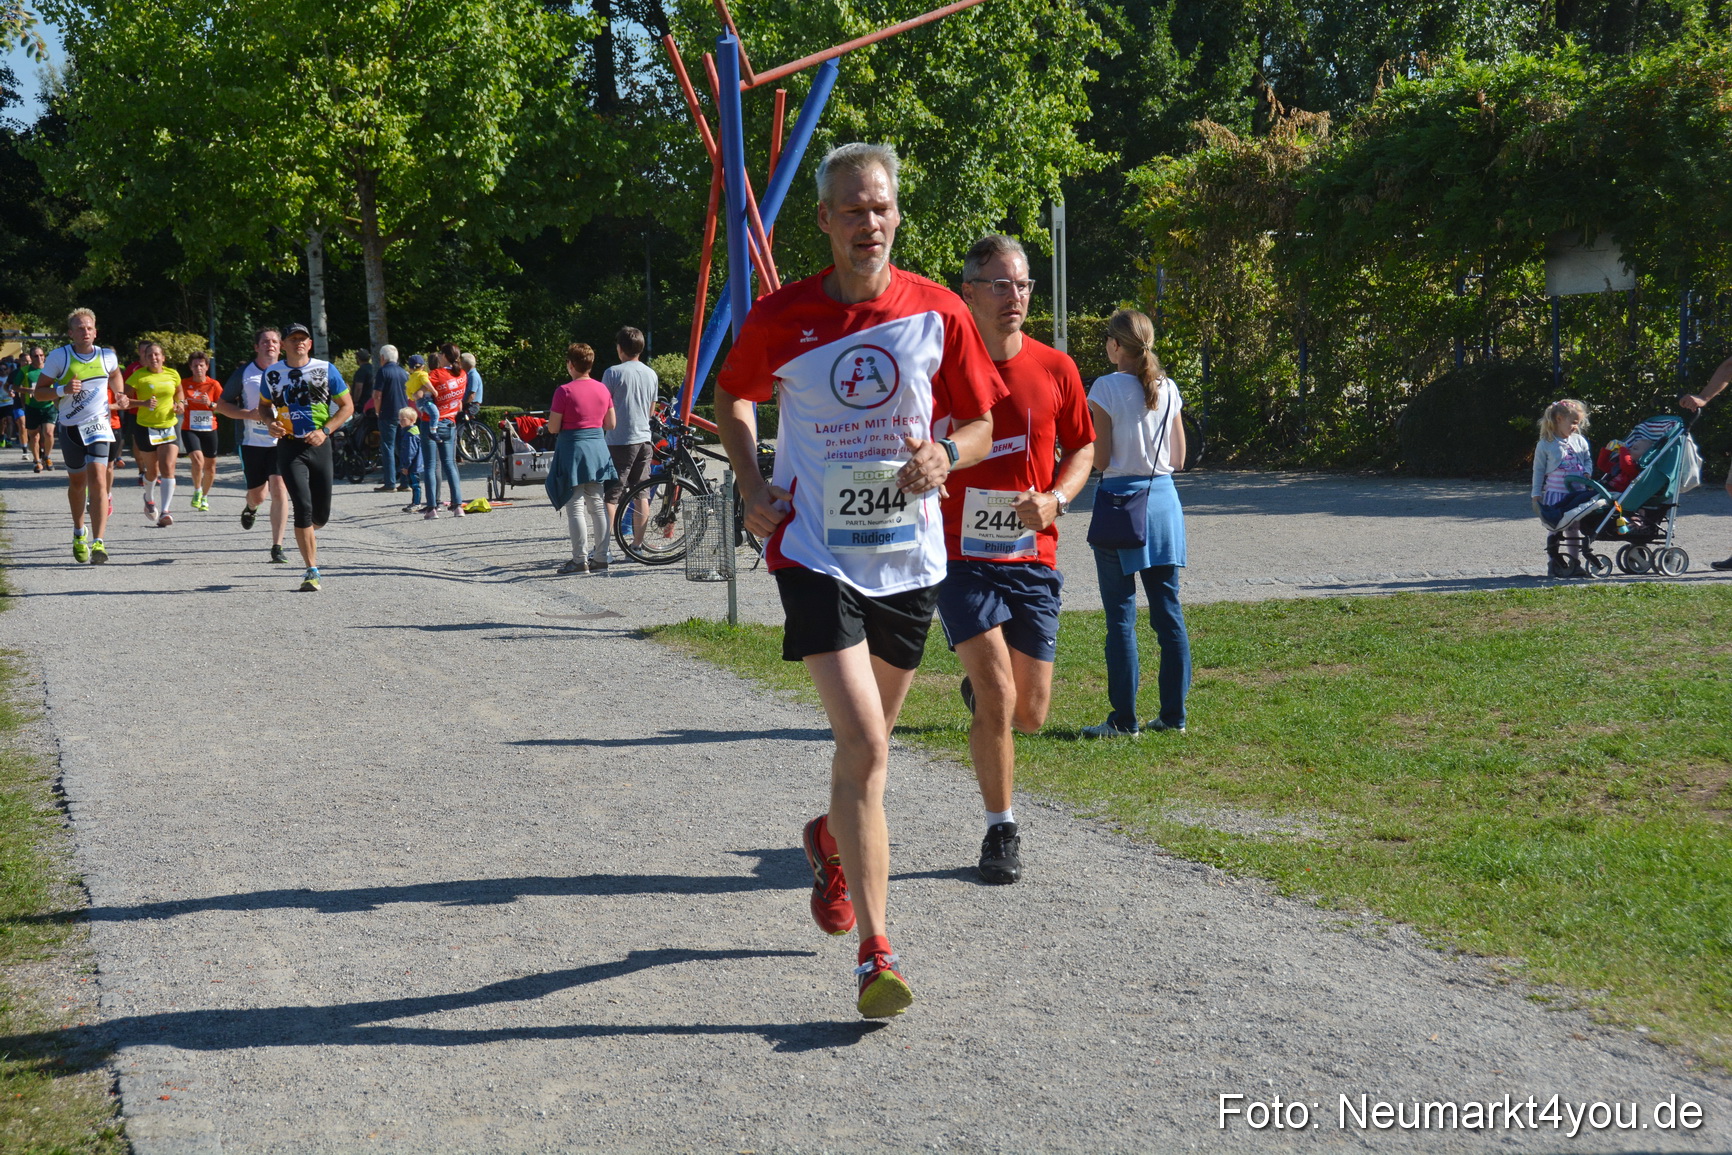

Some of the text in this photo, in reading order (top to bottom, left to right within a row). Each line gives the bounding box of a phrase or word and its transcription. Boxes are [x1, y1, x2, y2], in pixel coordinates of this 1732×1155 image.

[825, 439, 838, 447] Dr.
[840, 436, 862, 446] Heck
[870, 434, 881, 442] Dr.
[827, 445, 911, 460] Leistungsdiagnotik
[992, 441, 1014, 453] DEHN
[853, 469, 895, 481] BOCK
[839, 486, 908, 516] 2344
[988, 496, 1017, 505] BOC
[868, 518, 895, 526] Neumarkt
[852, 532, 896, 545] Rüdiger
[985, 541, 1016, 553] Philipp
